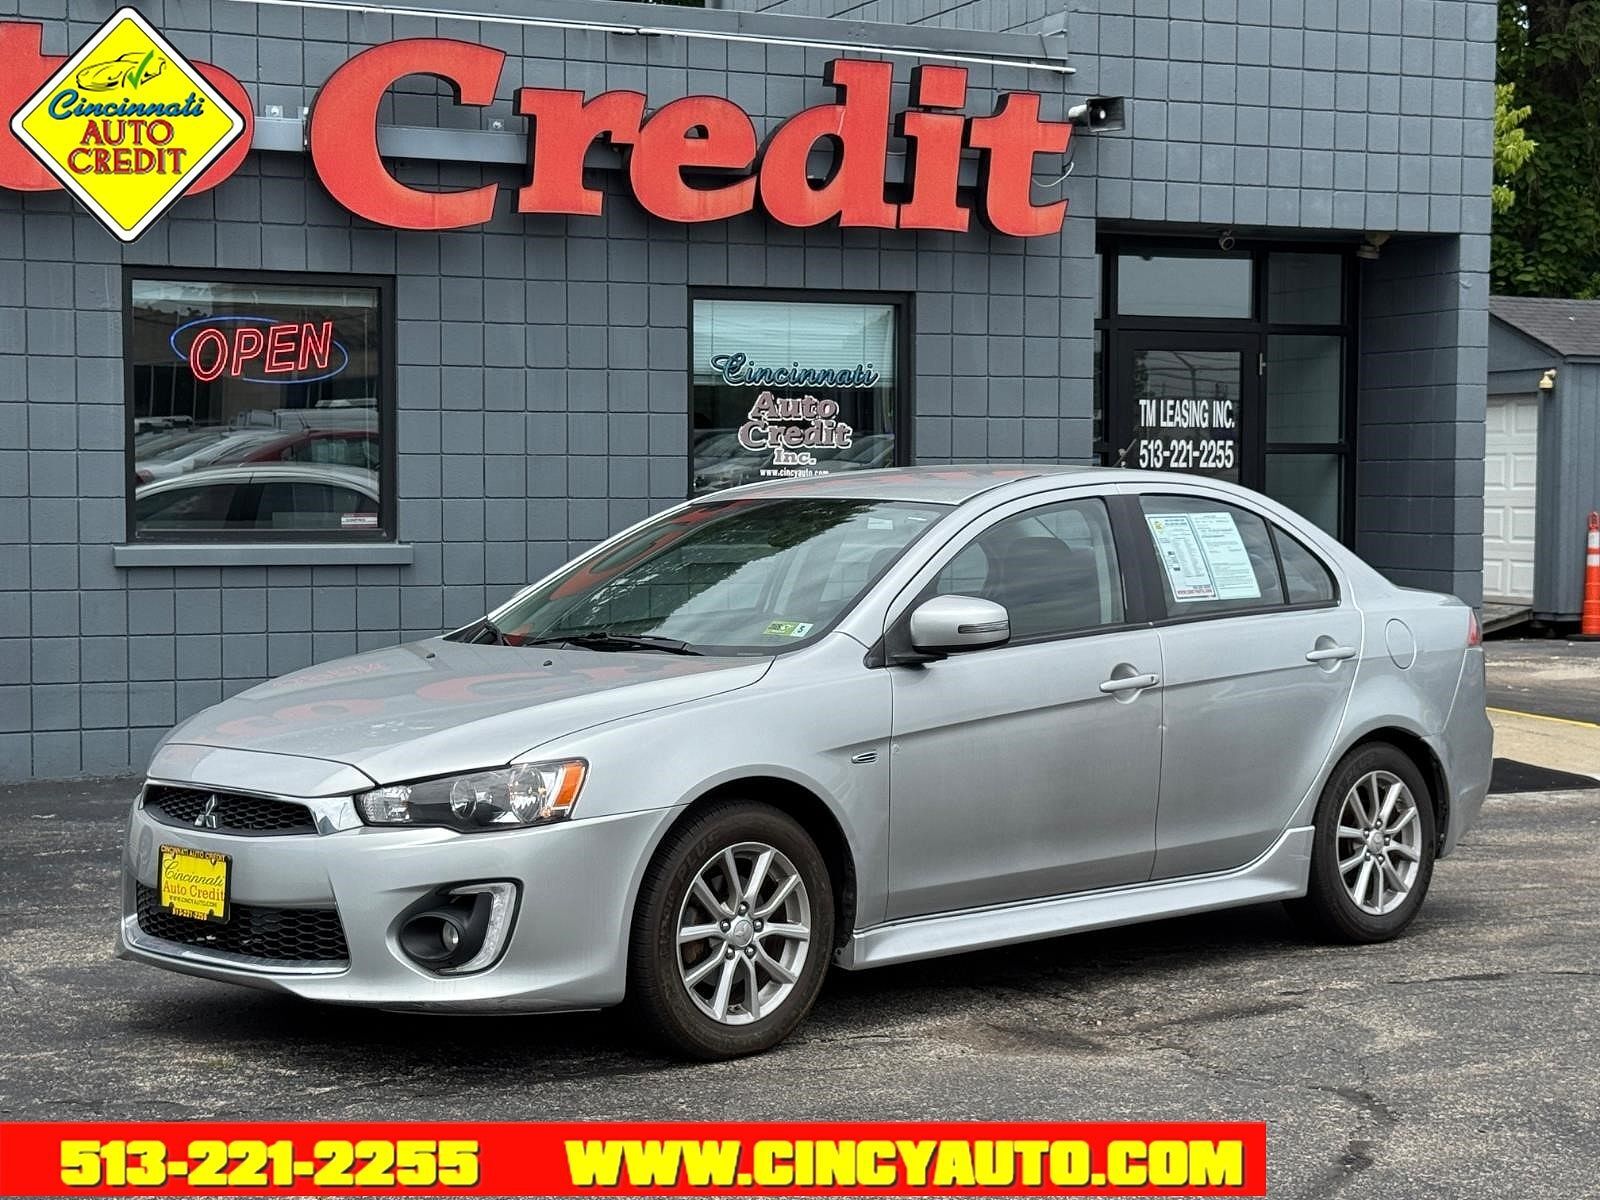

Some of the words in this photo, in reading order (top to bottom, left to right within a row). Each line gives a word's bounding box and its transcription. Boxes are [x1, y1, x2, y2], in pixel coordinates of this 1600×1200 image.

[311, 38, 1073, 236] Credit
[189, 321, 333, 382] OPEN
[711, 352, 879, 388] Cincinnati
[748, 390, 840, 422] Auto
[1139, 399, 1157, 428] TM
[1160, 399, 1209, 428] LEASING
[1213, 400, 1236, 429] INC.
[737, 417, 853, 451] Credit
[772, 449, 817, 466] Inc.
[1139, 439, 1235, 469] 513-221-2255
[164, 859, 225, 887] Cincinnati
[164, 880, 187, 896] Auto
[190, 885, 225, 901] Credit
